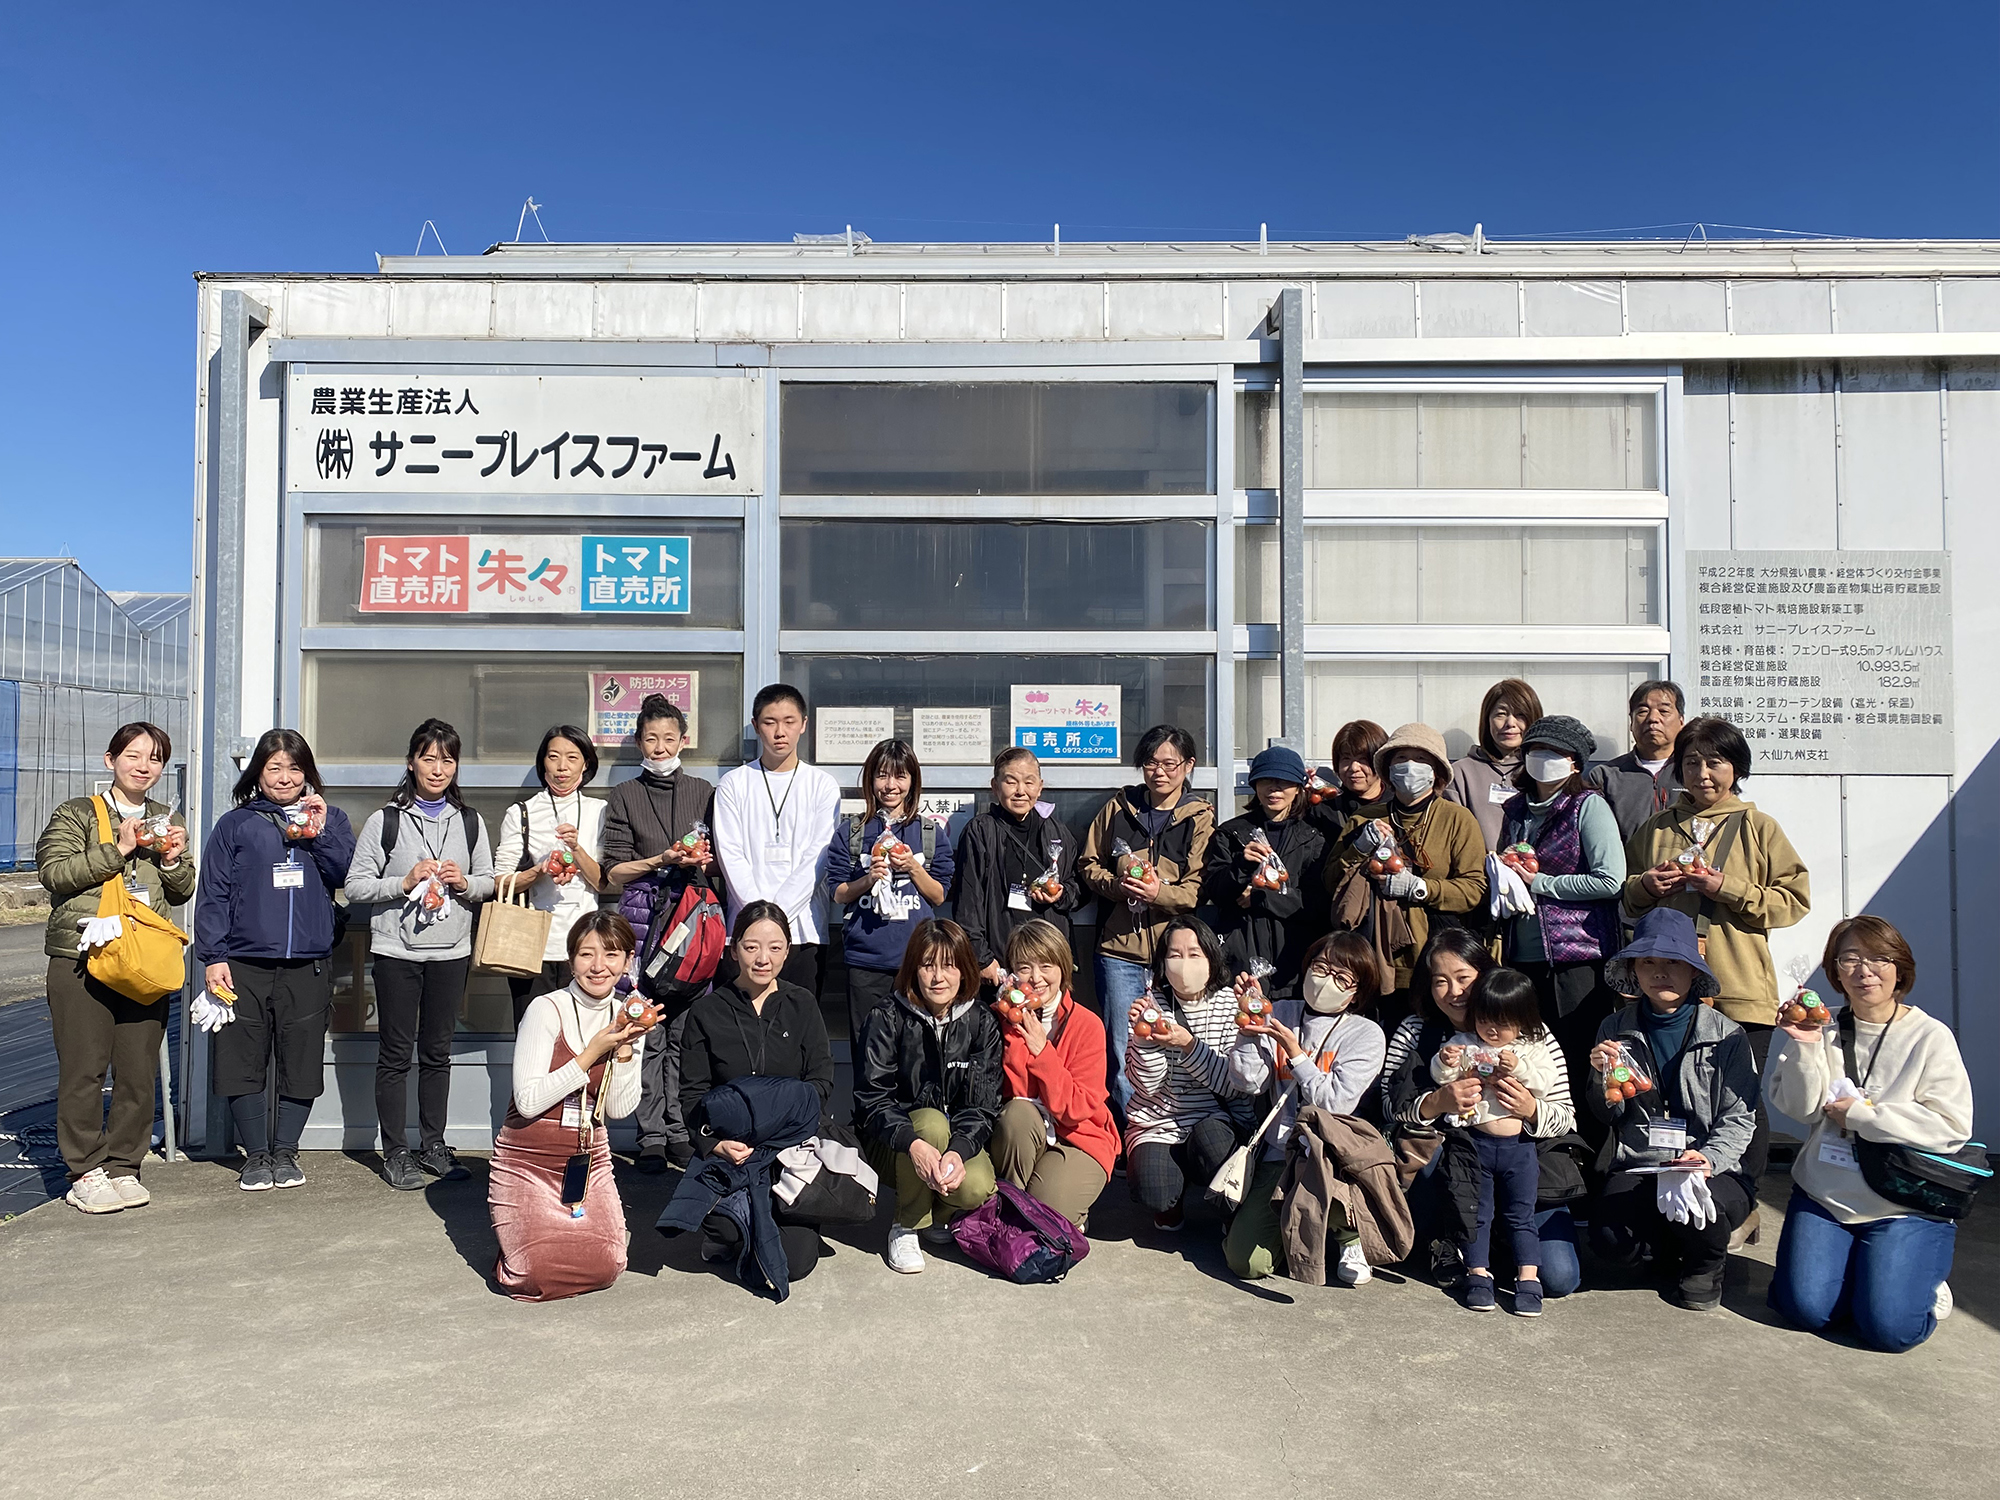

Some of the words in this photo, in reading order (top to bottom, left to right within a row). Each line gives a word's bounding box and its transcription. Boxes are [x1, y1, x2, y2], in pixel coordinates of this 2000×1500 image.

[311, 387, 480, 416] 農業生産法人
[369, 430, 736, 481] サニープレイスファーム
[377, 544, 459, 572] トマト
[595, 544, 680, 572] トマト
[476, 548, 569, 597] 朱々
[1699, 567, 1755, 578] 平成22年度
[369, 574, 461, 605] 直売所
[589, 574, 681, 605] 直売所
[509, 595, 545, 603] しゅしゅ
[1699, 603, 1864, 614] 低段密植トマト栽培施設新築工事
[1700, 624, 1743, 635] 株式会社
[1755, 624, 1875, 635] サニープレイスファーム
[1700, 660, 1787, 671] 複合経営促進施設
[630, 677, 688, 690] 防犯カメラ
[1700, 676, 1821, 687] 農畜産物集出荷貯蔵施設
[1075, 699, 1109, 716] 朱々
[1022, 732, 1081, 747] 直売所
[1760, 749, 1829, 761] 大仙九州支社
